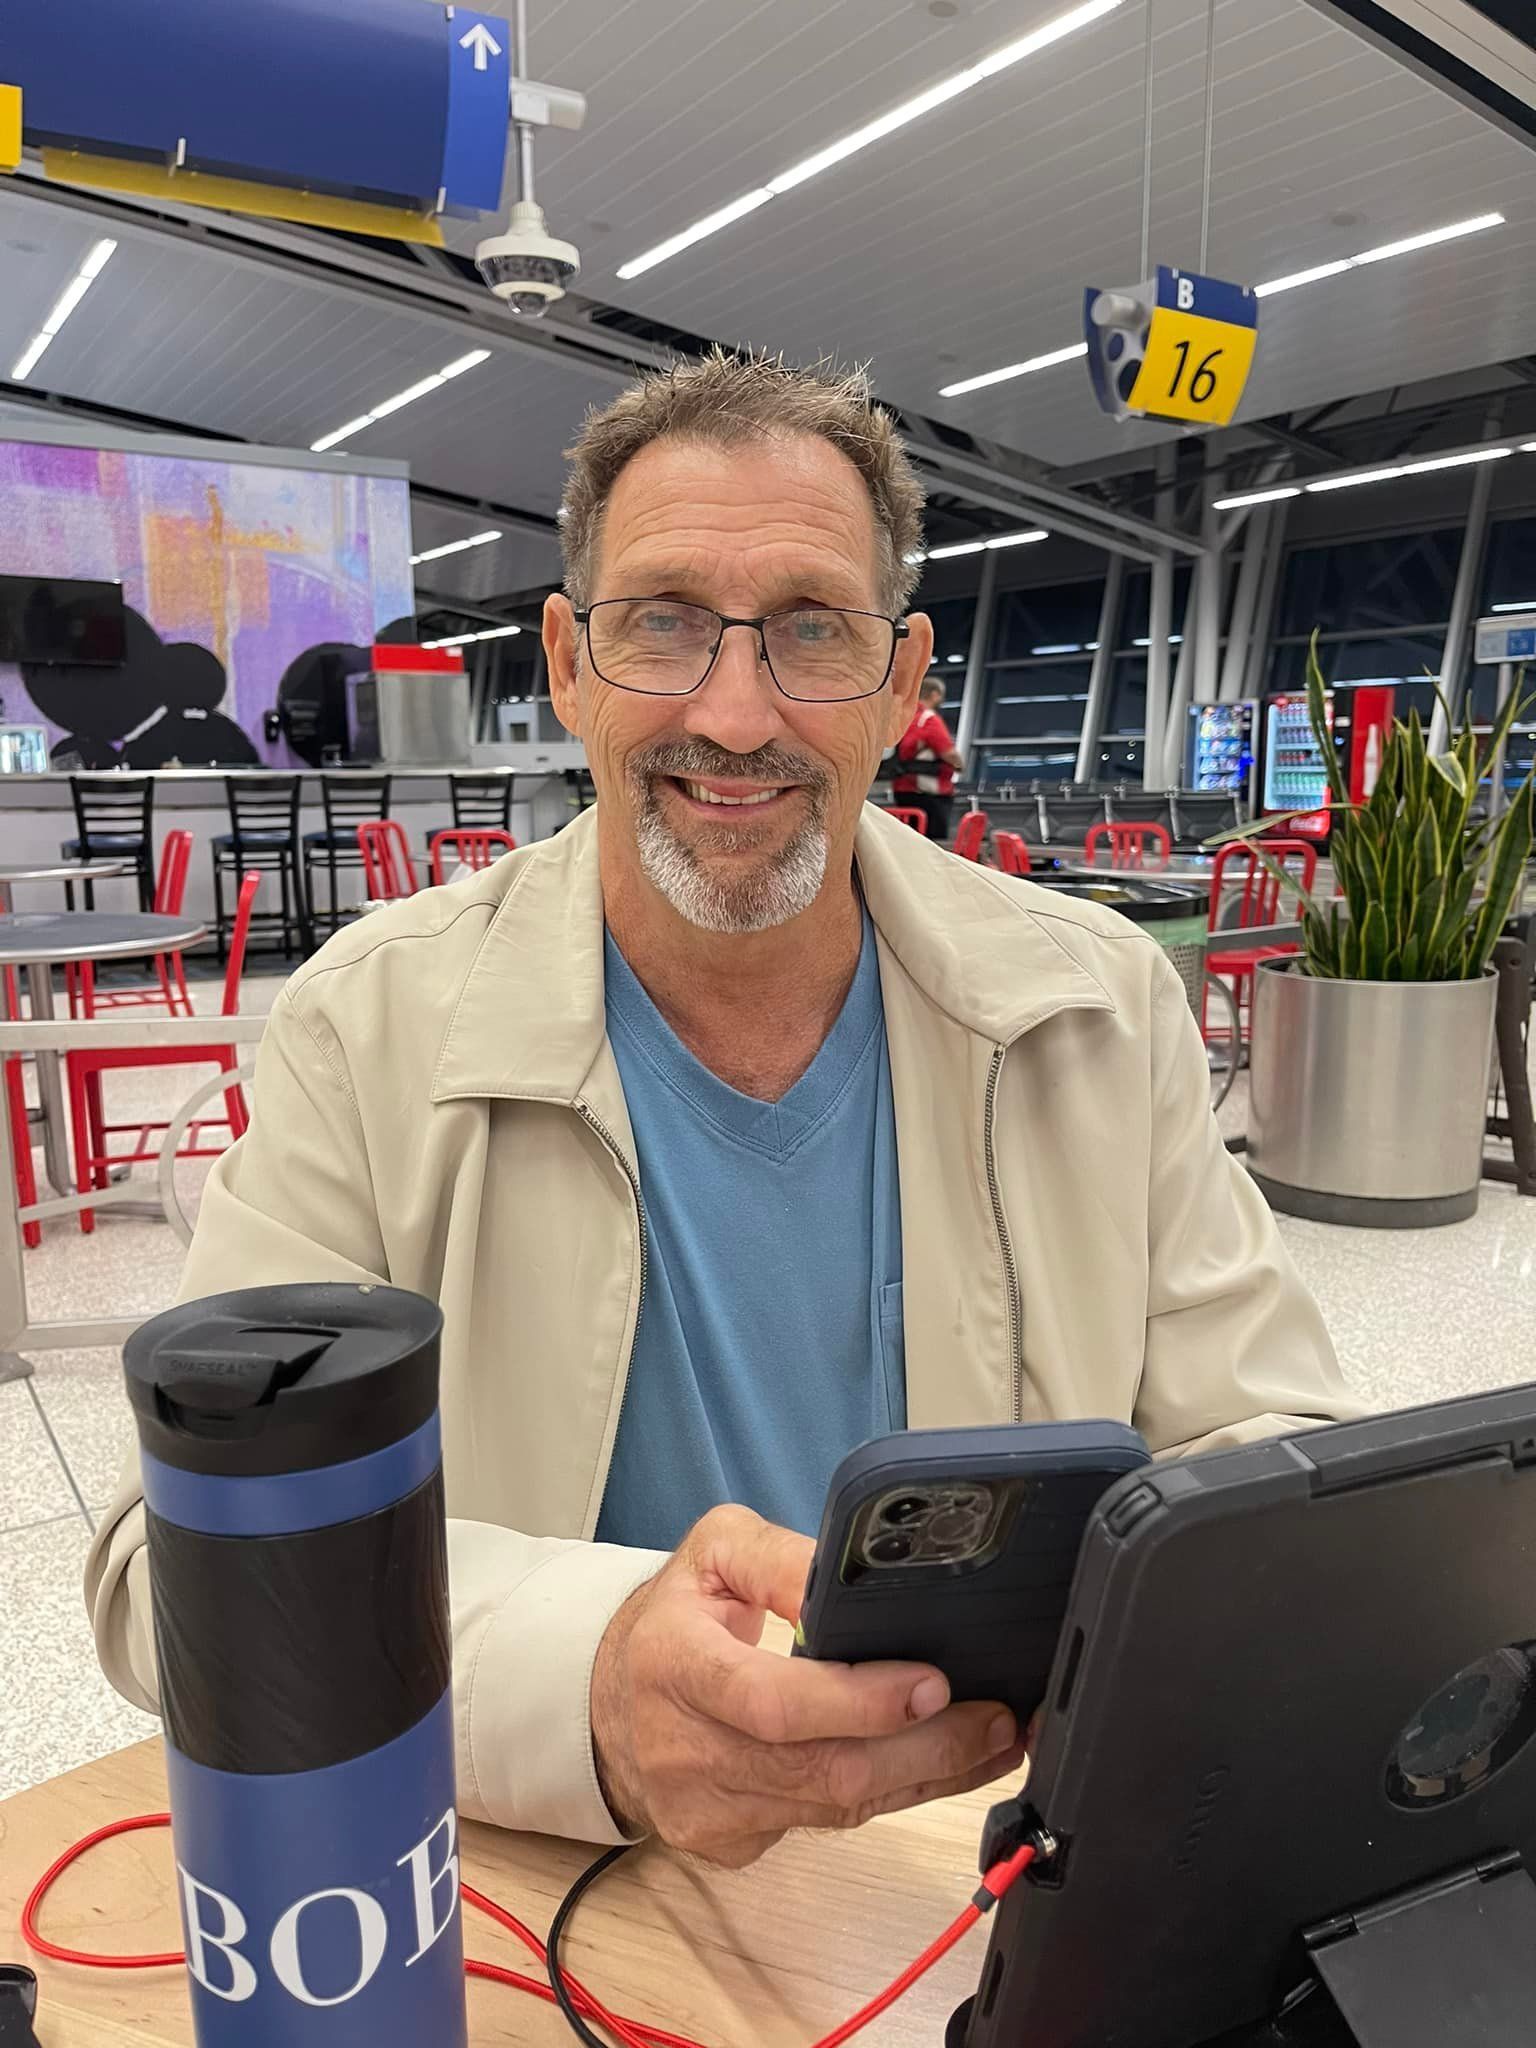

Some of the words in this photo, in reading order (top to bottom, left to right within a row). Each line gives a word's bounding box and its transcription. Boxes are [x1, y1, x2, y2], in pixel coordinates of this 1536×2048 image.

[1177, 278, 1195, 310] B
[1168, 340, 1223, 403] 16
[177, 1807, 459, 2006] BOB
